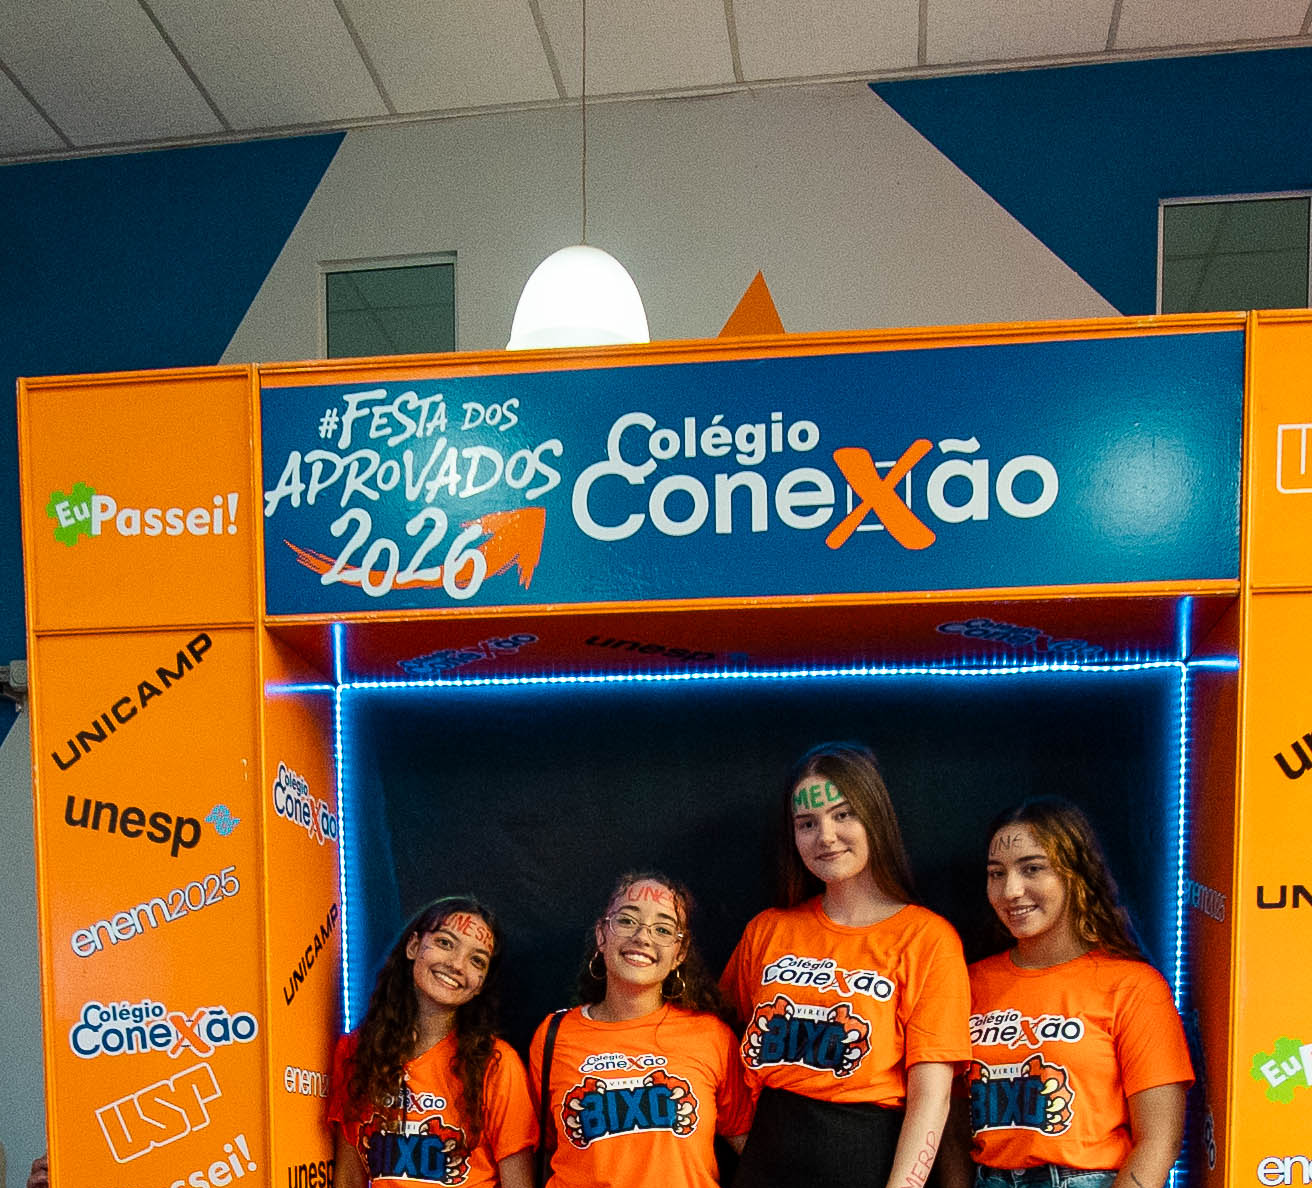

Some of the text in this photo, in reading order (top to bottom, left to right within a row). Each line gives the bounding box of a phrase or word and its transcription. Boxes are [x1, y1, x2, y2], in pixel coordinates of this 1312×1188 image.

[318, 389, 519, 449] #FESTA DOS
[608, 411, 820, 471] Colégio
[264, 437, 563, 516] APROVADOS
[55, 492, 239, 538] Eu Passei!
[321, 507, 488, 600] 2026
[51, 633, 213, 771] UNICAMP
[65, 795, 202, 857] unesp
[70, 866, 240, 957] enem2025
[283, 903, 339, 1006] UNICAMP
[81, 1002, 164, 1028] Colégio
[284, 1065, 328, 1098] enem2
[1260, 1055, 1302, 1088] Eu
[95, 1062, 222, 1164] USP
[581, 1086, 678, 1139] BIXO
